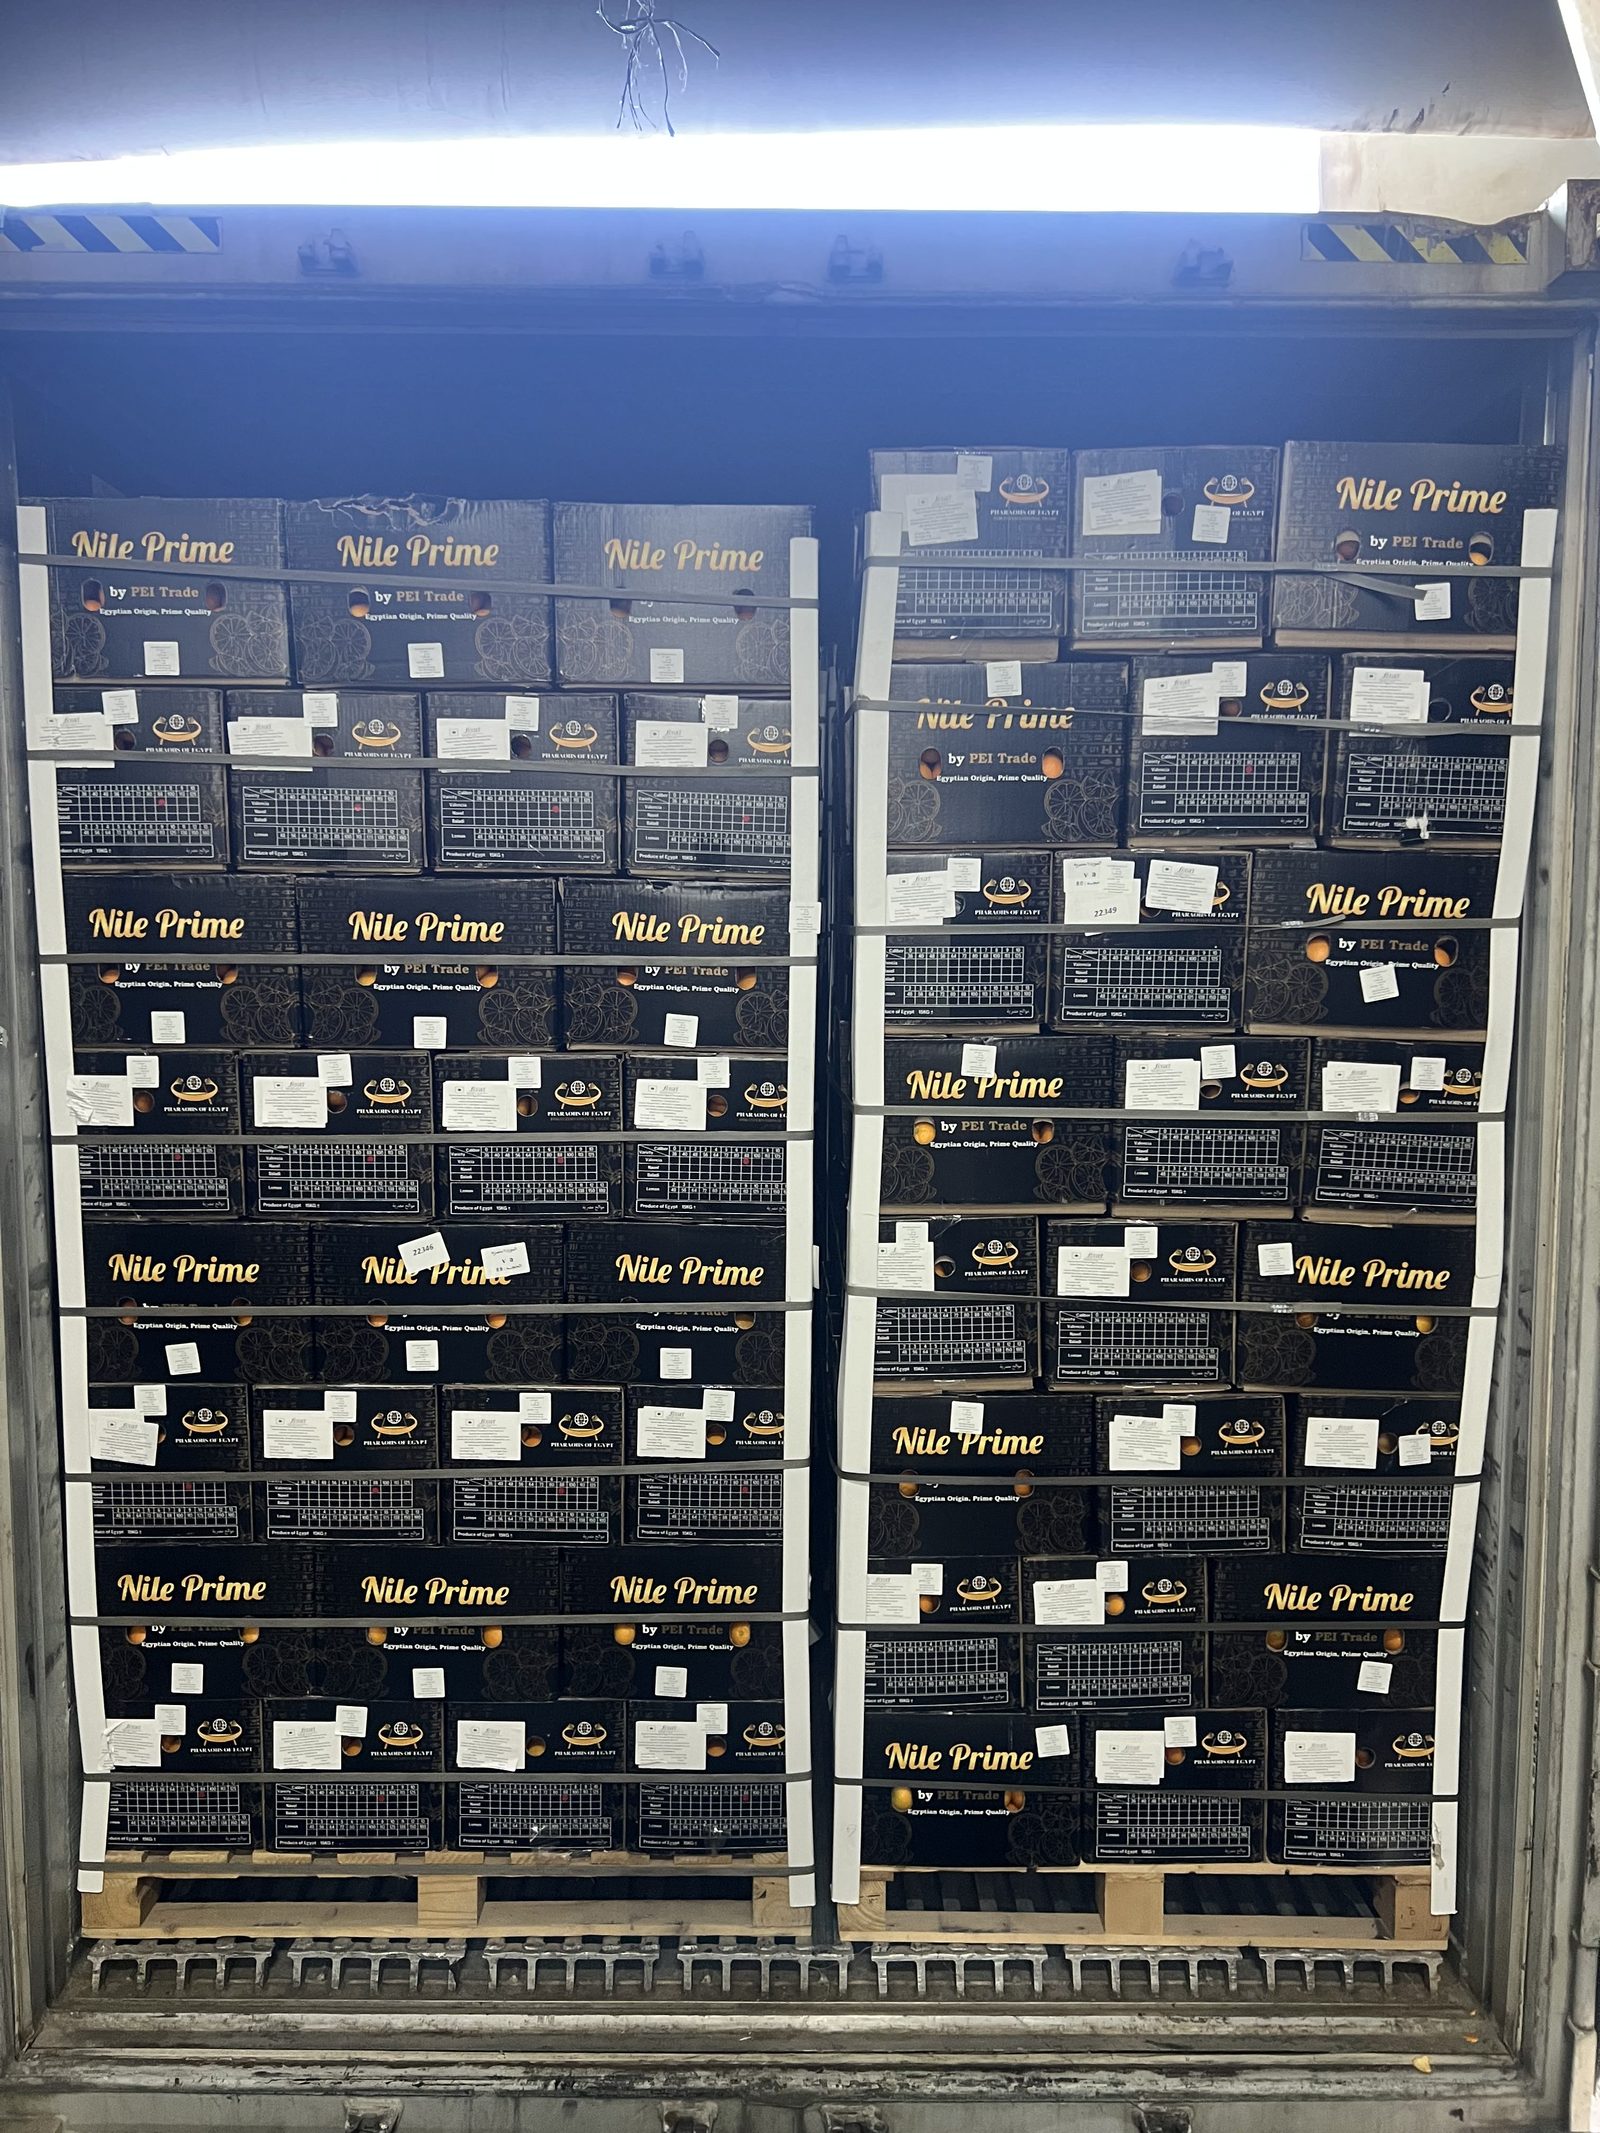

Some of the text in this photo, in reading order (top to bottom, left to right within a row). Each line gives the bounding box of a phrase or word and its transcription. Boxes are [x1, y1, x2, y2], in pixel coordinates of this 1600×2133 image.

[1335, 476, 1507, 515] Nile Prime
[71, 529, 234, 563] Nile Prime
[337, 534, 498, 567] Nile Prime
[1370, 535, 1463, 550] by PEI Trade
[604, 537, 763, 572] Nile Prime
[109, 586, 199, 600] by PEI Trade
[375, 590, 464, 604] by PEI Trade
[365, 612, 397, 621] Egyptian
[663, 616, 687, 624] Origin,
[949, 753, 1037, 766] by PEI Trade
[937, 774, 968, 782] Egyptian
[1021, 774, 1049, 782] Quality
[1305, 882, 1470, 919] Nile Prime
[88, 908, 245, 939] Nile Prime
[348, 910, 504, 942] Nile Prime
[612, 911, 765, 945] Nile Prime
[1339, 938, 1428, 952] by PEI Trade
[384, 964, 469, 975] by PEI Trade
[645, 965, 728, 976] by PEI Trade
[714, 985, 739, 993] Quality
[906, 1070, 966, 1099] Nile
[941, 1120, 1027, 1134] by PEI Trade
[930, 1140, 961, 1148] Egyptian
[1012, 1140, 1039, 1148] Quality
[108, 1253, 260, 1283] Nile Prime
[615, 1254, 764, 1286] Nile Prime
[1295, 1255, 1450, 1291] Nile Prime
[714, 1325, 740, 1333] Quality
[892, 1426, 1044, 1455] Nile Prime
[117, 1574, 266, 1601] Nile Prime
[361, 1575, 509, 1605] Nile Prime
[610, 1575, 757, 1605] Nile Prime
[1263, 1582, 1414, 1612] Nile Prime
[642, 1624, 723, 1636] by PEI Trade
[1295, 1631, 1377, 1643] by PEI Trade
[1363, 1650, 1389, 1658] Quality
[885, 1742, 1033, 1771] Nile Prime
[918, 1790, 999, 1802] by PEI Trade
